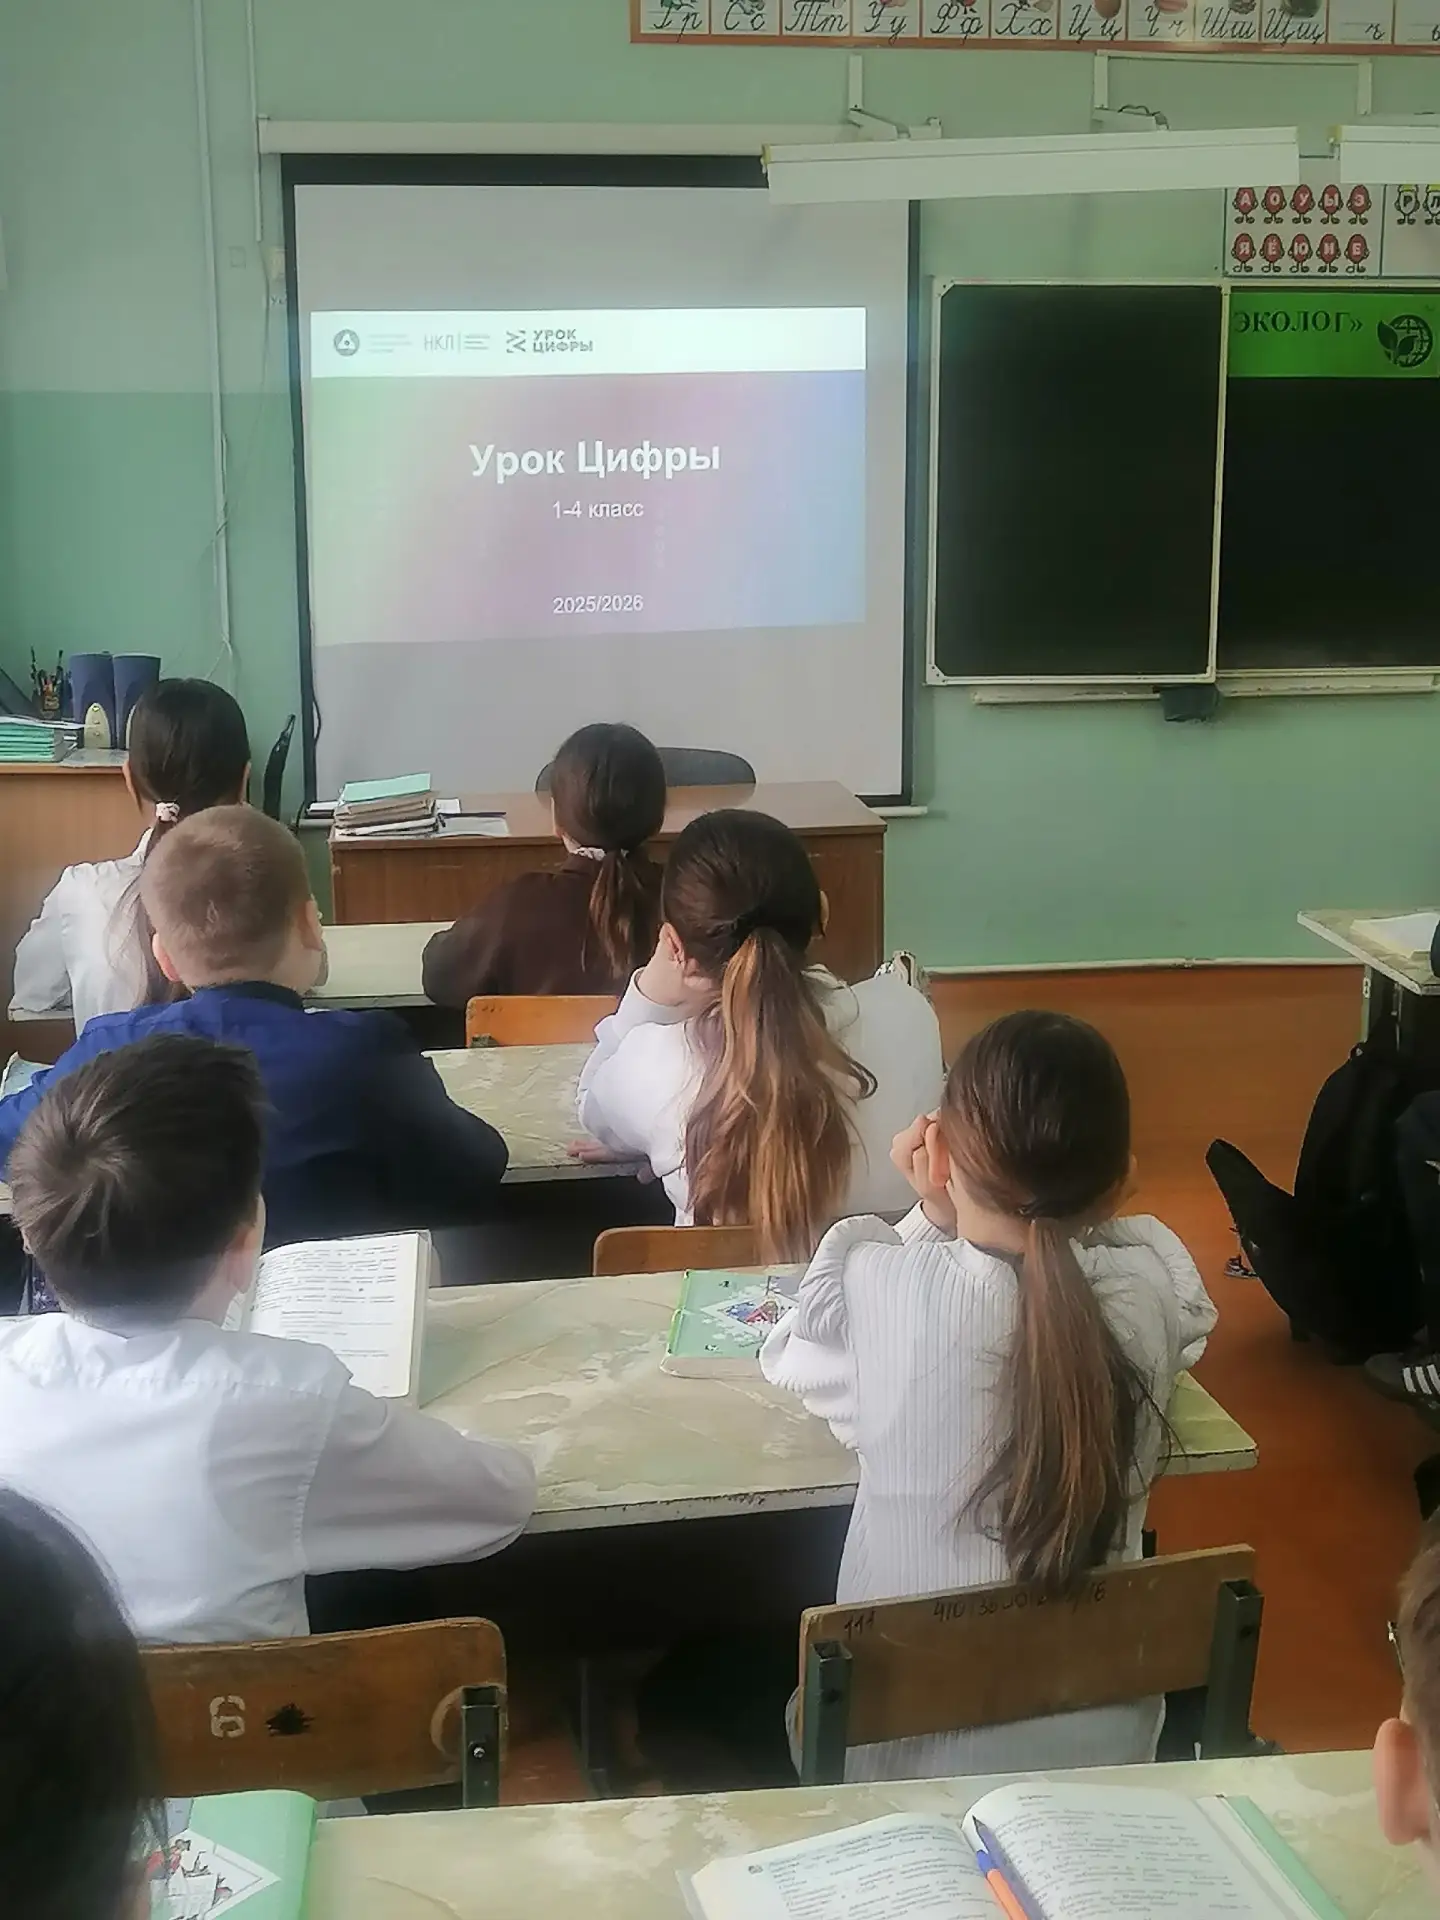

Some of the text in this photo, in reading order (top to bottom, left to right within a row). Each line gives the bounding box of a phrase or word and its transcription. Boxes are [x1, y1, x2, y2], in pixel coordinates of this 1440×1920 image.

[1240, 192, 1251, 206] А
[1269, 192, 1280, 206] О
[1299, 191, 1310, 206] У
[1323, 193, 1339, 206] Ы
[1403, 195, 1413, 207] Р
[1239, 242, 1250, 255] Я
[1294, 242, 1309, 255] Ю
[1234, 309, 1363, 333] ЭКОЛОГ»
[533, 328, 576, 341] УРОК
[533, 340, 593, 353] ЦИФРЫ
[469, 440, 720, 484] Урок Цифры
[588, 502, 644, 518] класс
[552, 595, 645, 614] 2025/2026
[209, 1695, 246, 1738] 6
